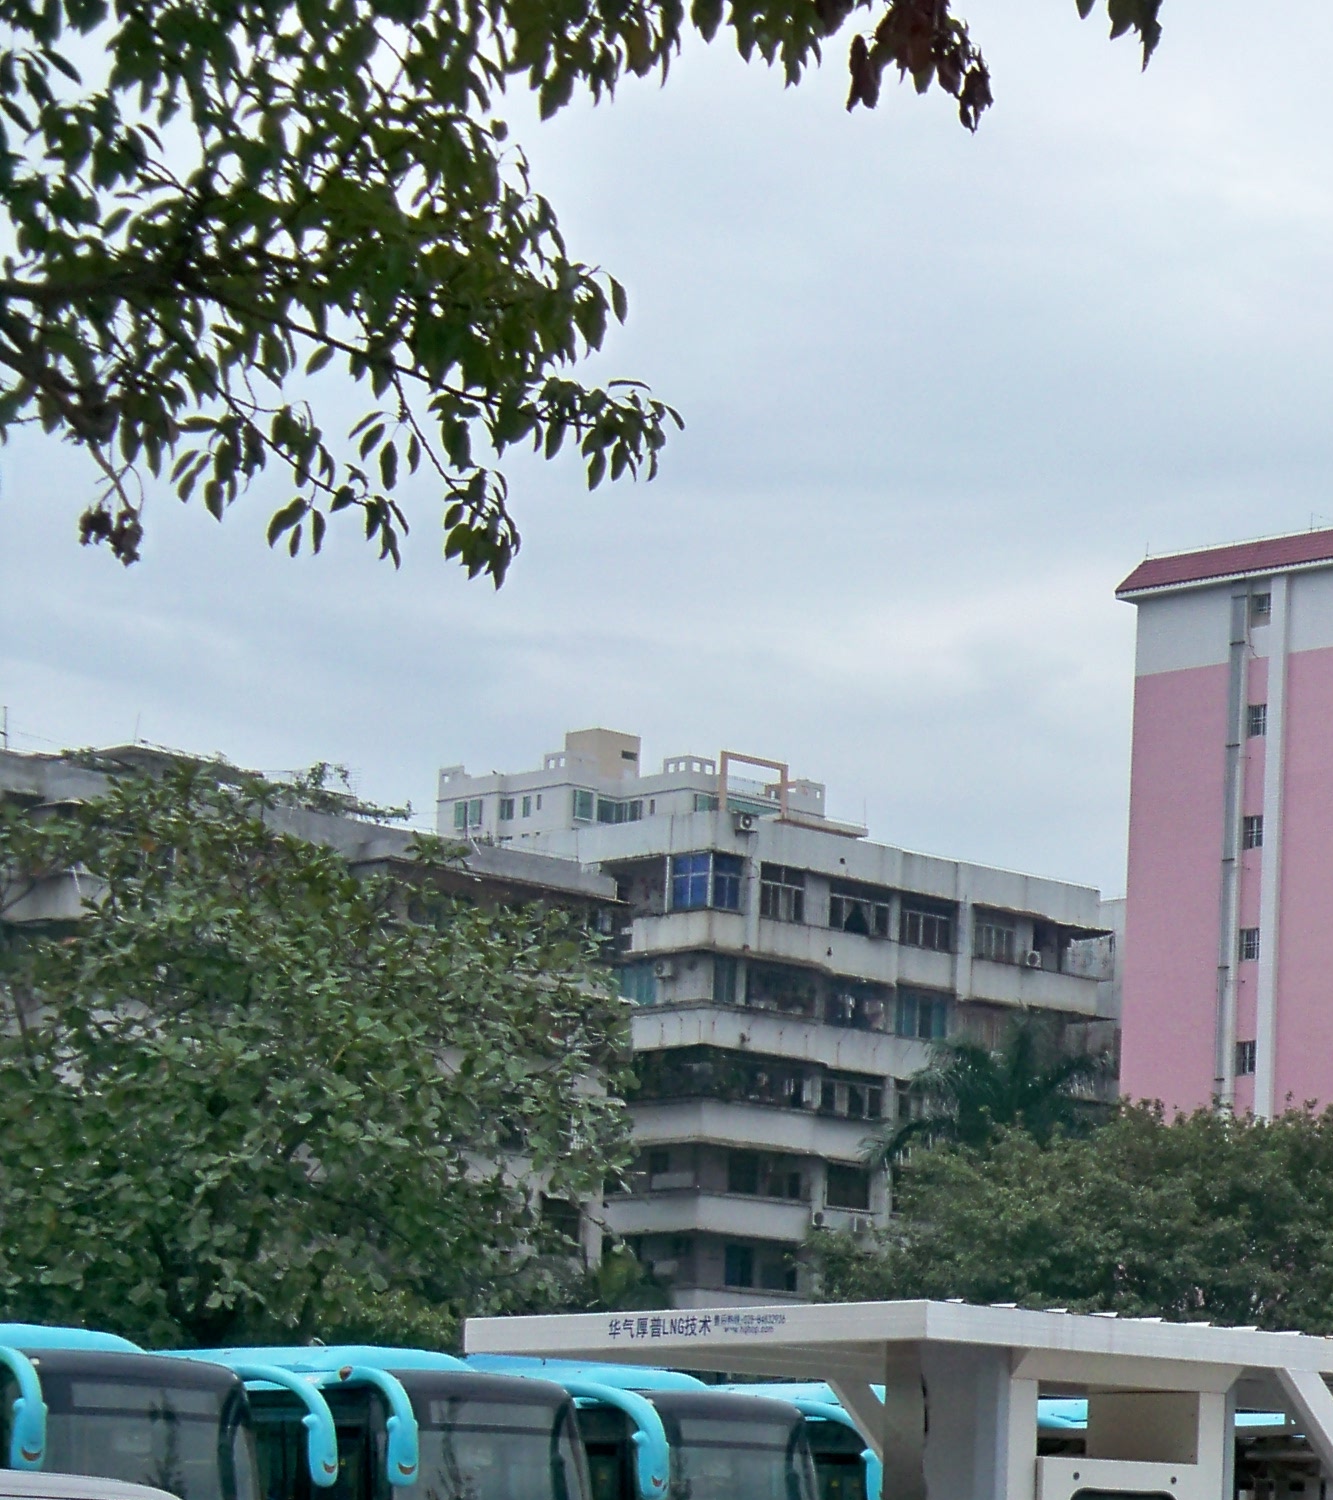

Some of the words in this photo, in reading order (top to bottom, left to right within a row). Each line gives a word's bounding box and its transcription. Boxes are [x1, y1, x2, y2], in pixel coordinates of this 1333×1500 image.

[608, 1315, 712, 1339] 华气厚普LNG技术
